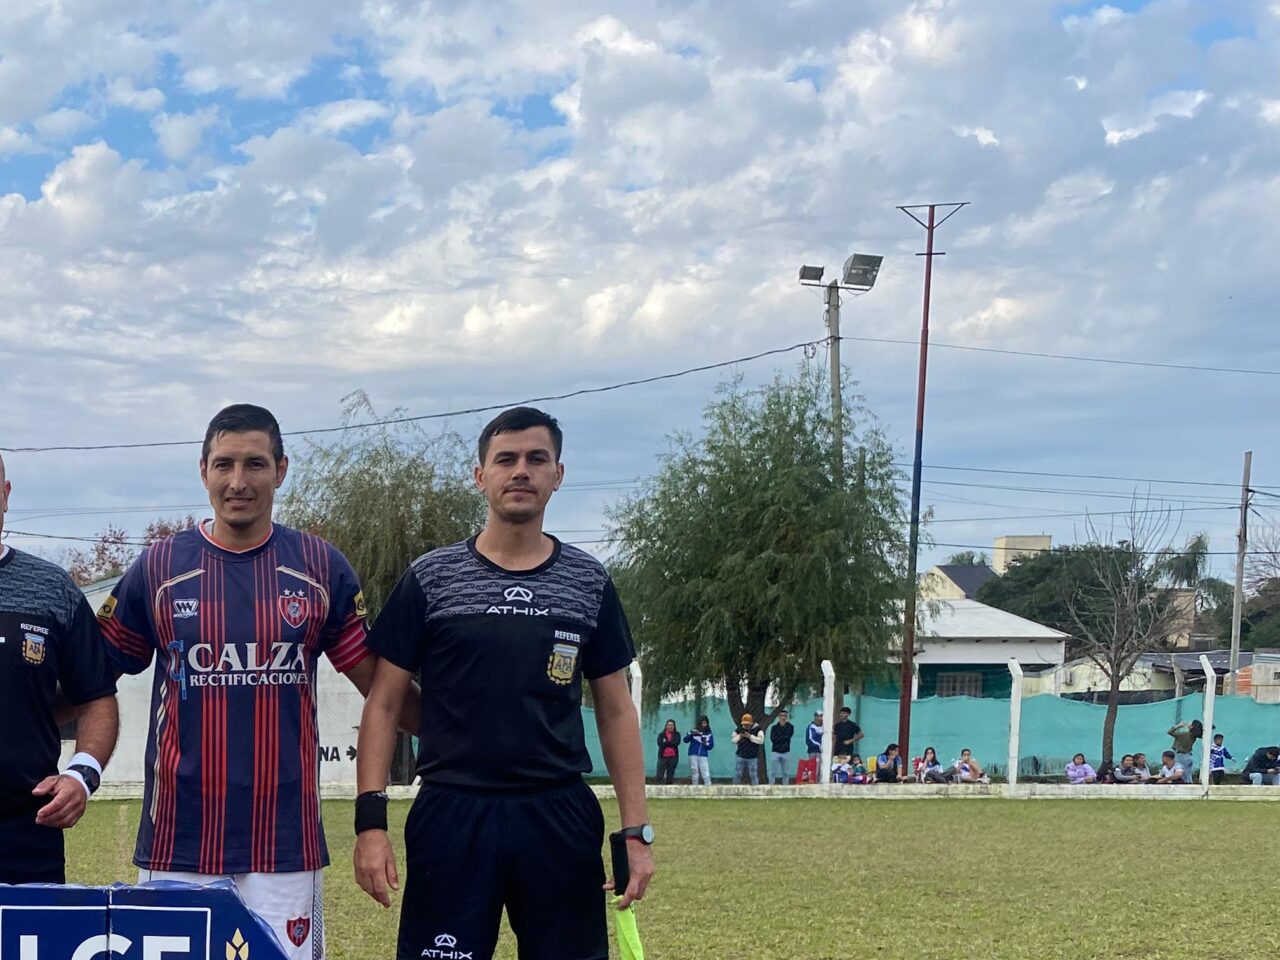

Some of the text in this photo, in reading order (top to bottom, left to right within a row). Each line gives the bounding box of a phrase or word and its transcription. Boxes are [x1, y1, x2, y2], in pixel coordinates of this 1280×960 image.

[485, 605, 549, 616] ATHIX
[20, 622, 49, 635] REFEREE
[554, 629, 581, 643] REFEREE
[421, 948, 473, 960] ATHIX
